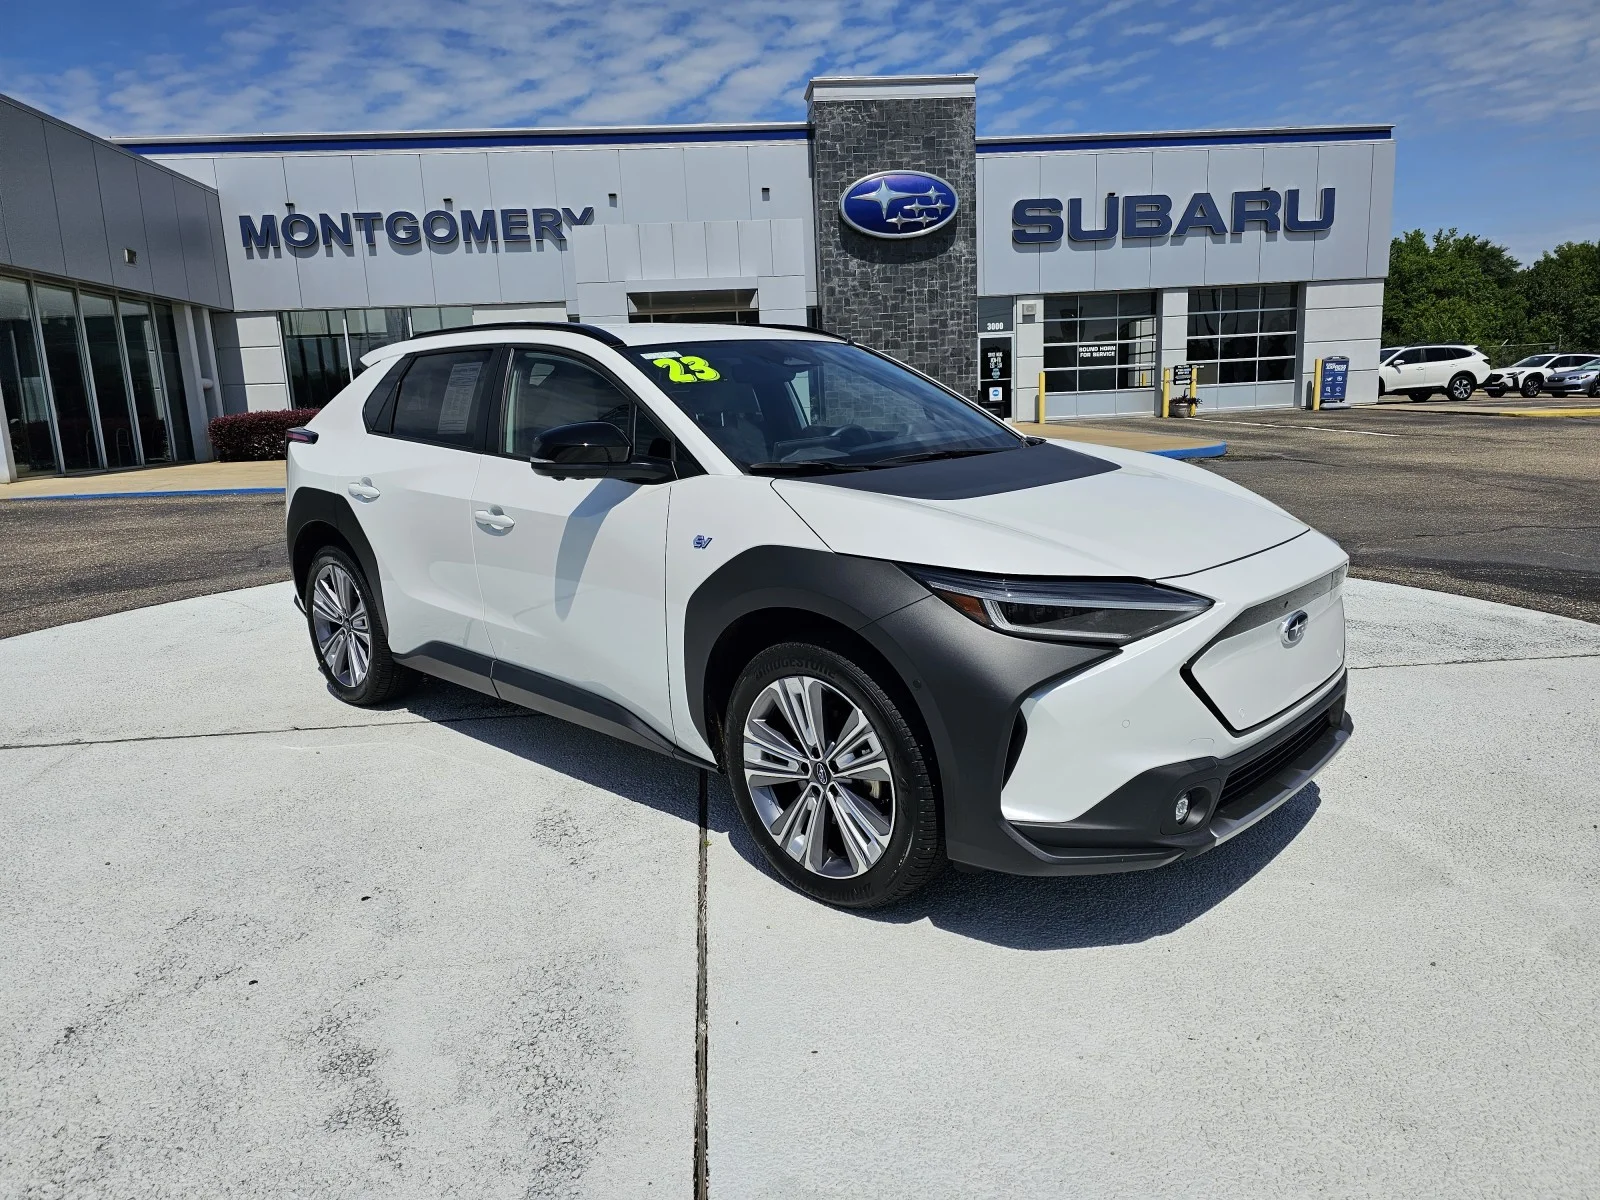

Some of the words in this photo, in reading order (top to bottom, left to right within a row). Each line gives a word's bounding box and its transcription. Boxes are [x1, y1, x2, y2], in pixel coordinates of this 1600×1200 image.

[238, 207, 594, 248] MONTGOMERY
[1012, 188, 1336, 243] SUBARU
[987, 322, 1004, 331] 3000
[652, 356, 721, 384] 23
[754, 656, 836, 681] BRIDGESTONE
